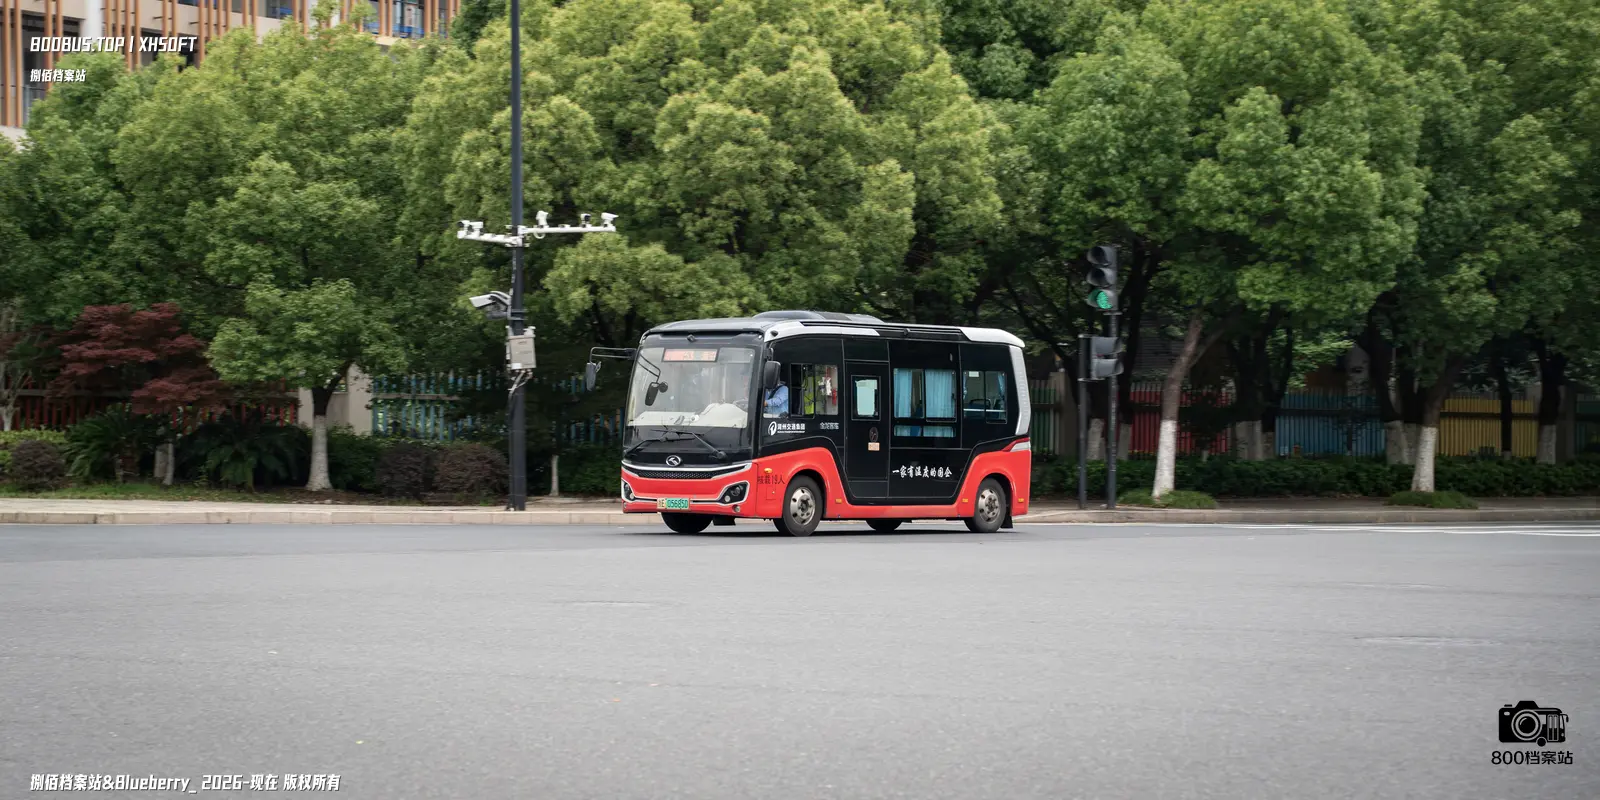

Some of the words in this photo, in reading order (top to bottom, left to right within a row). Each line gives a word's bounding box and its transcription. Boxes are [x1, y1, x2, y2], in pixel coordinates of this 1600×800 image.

[892, 465, 952, 478] 一家有温度的国企
